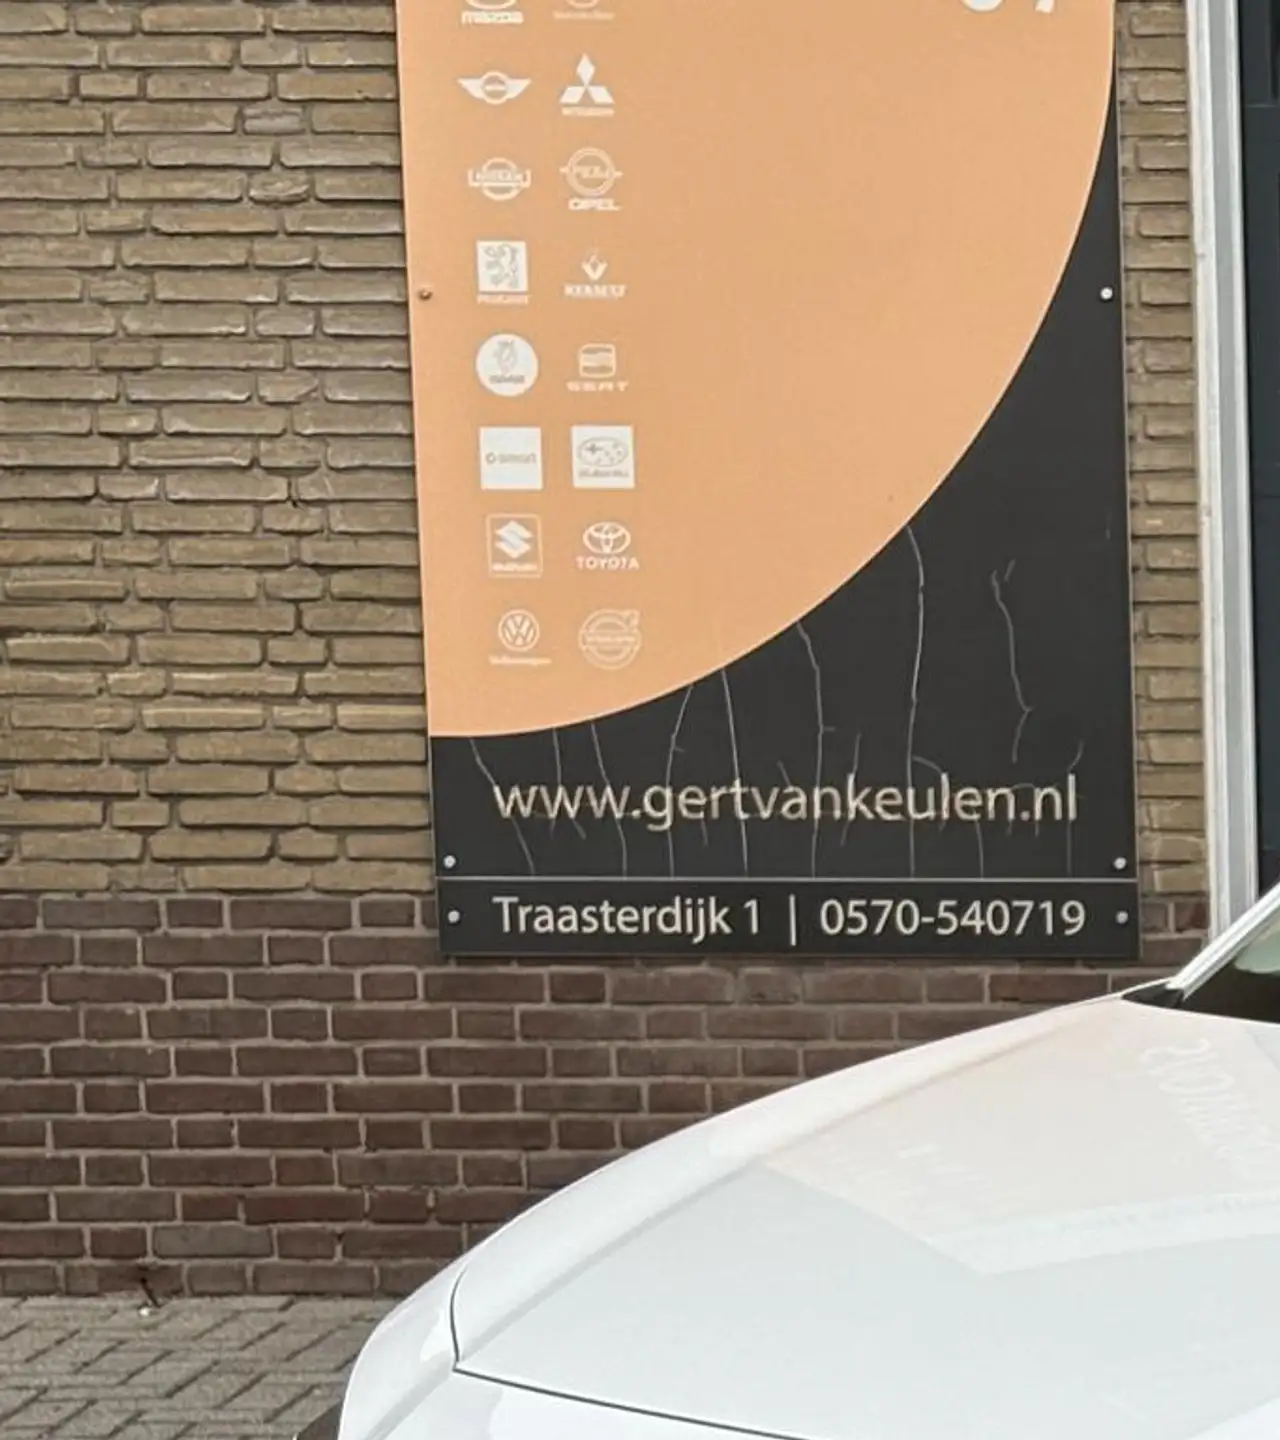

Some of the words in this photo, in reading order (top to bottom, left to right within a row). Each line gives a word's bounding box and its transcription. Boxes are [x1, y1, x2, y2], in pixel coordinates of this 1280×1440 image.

[576, 556, 640, 571] TOYOTA
[493, 772, 1078, 832] www.gertvankeulen.nl
[492, 895, 732, 944] Traasterdijk
[744, 898, 760, 935] 1
[819, 898, 1086, 936] 0570-540719
